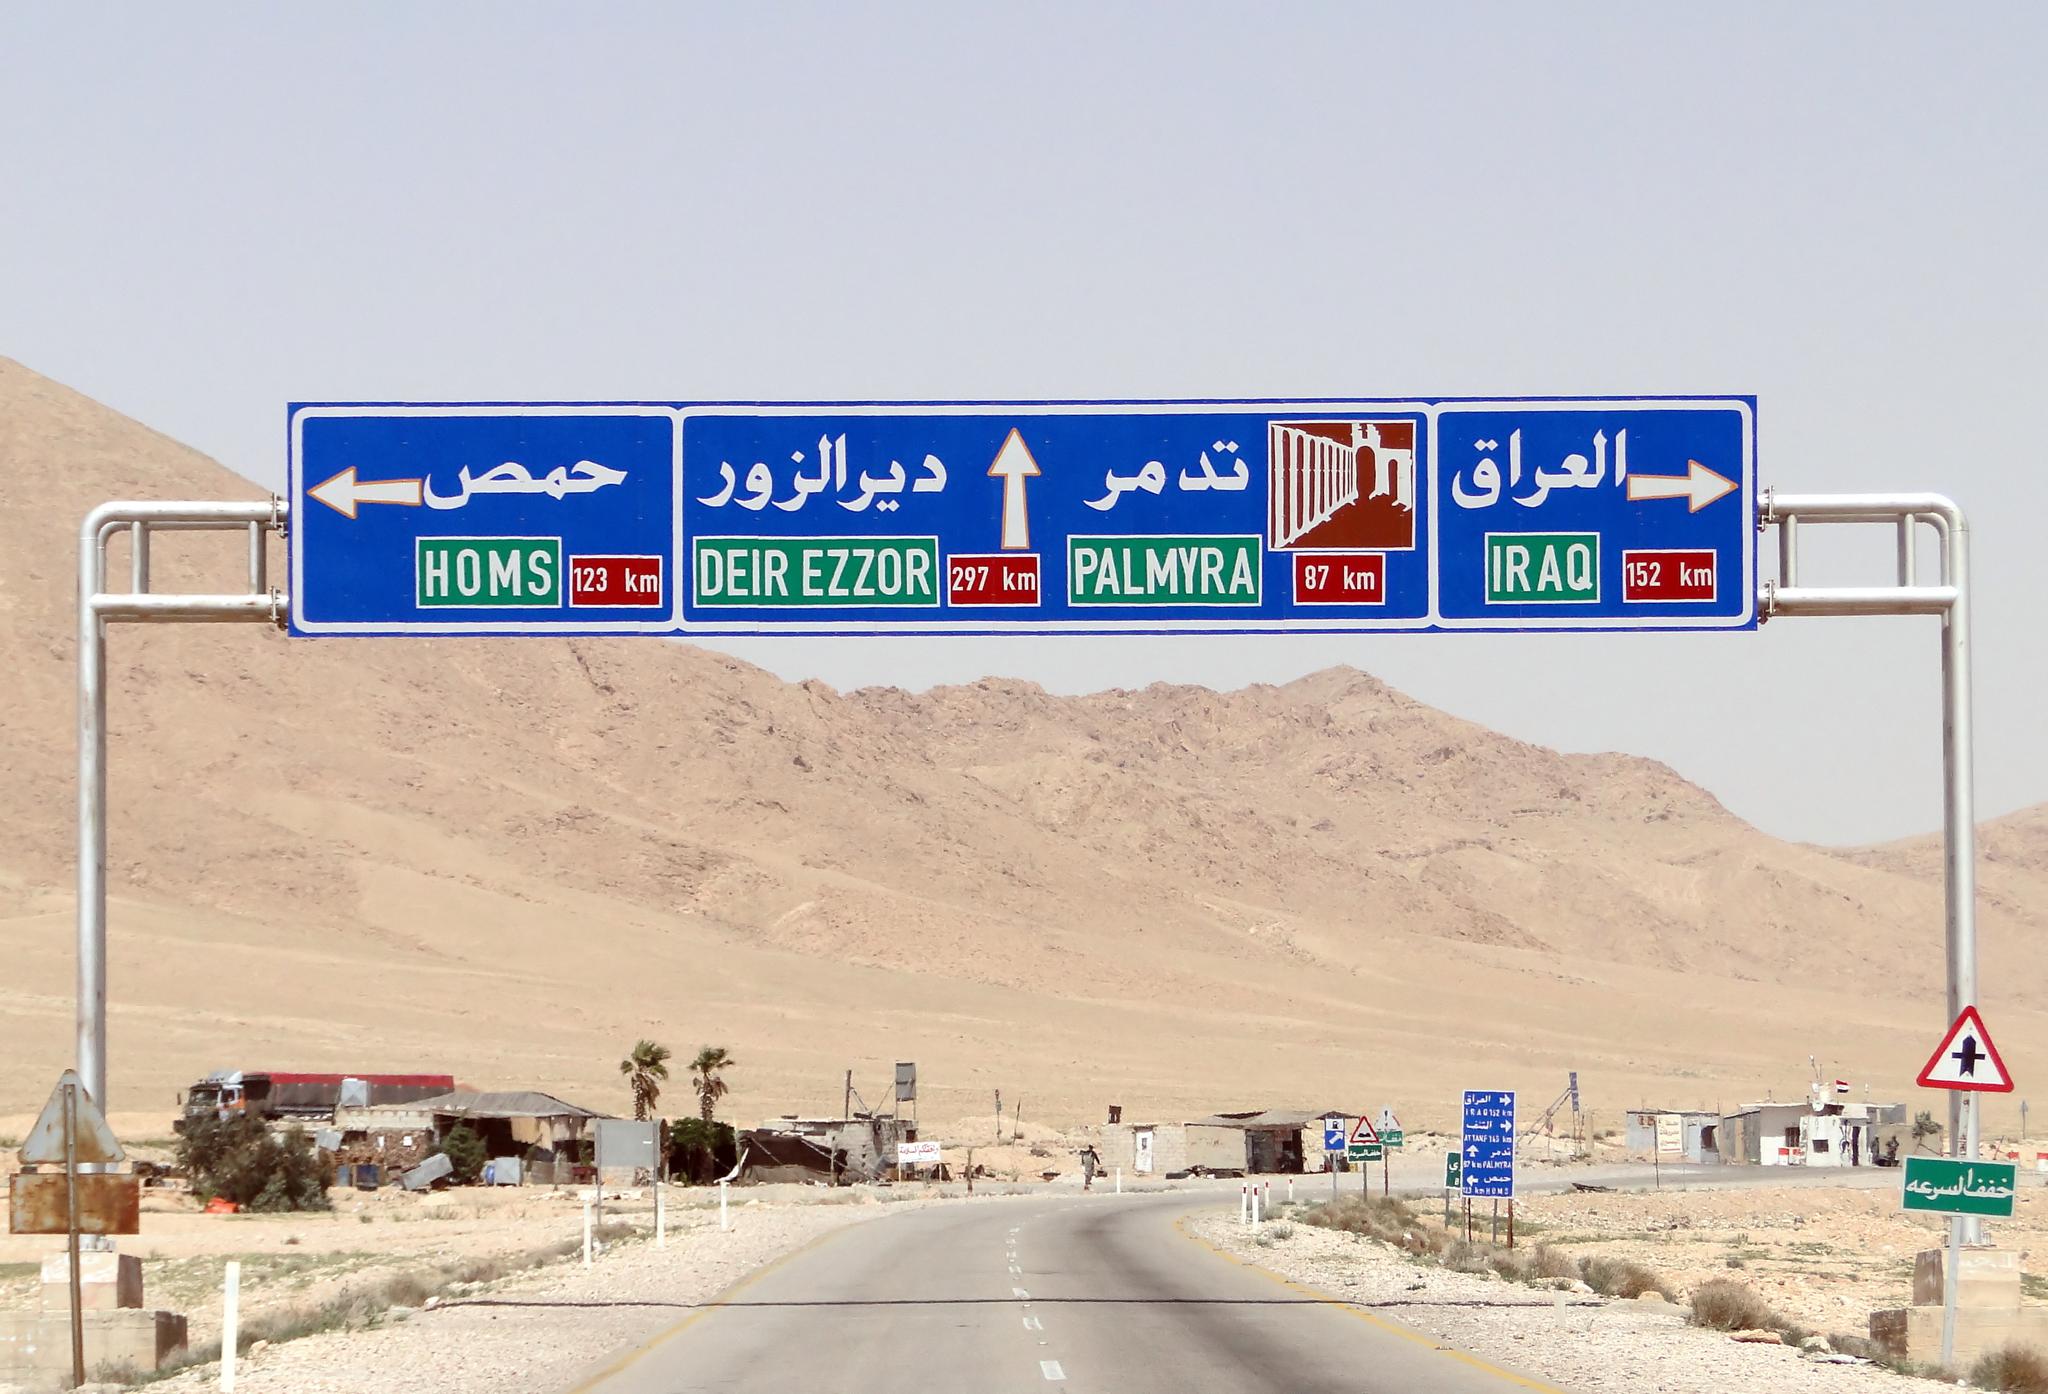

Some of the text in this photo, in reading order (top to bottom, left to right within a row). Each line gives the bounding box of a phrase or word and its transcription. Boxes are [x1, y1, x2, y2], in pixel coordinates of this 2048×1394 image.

[423, 460, 628, 510] حمص
[1084, 440, 1250, 511] تدمر
[1451, 428, 1627, 509] العراق
[425, 548, 552, 597] HOMS
[573, 567, 658, 593] 123 km
[700, 547, 931, 597] DEIR EZZOR
[951, 566, 1036, 592] 297 km
[1074, 547, 1255, 596] PALMYRA
[1304, 564, 1375, 591] 87 km
[1492, 543, 1593, 593] IRAQ
[1626, 562, 1713, 588] 152 km
[1464, 1094, 1491, 1105] العراق
